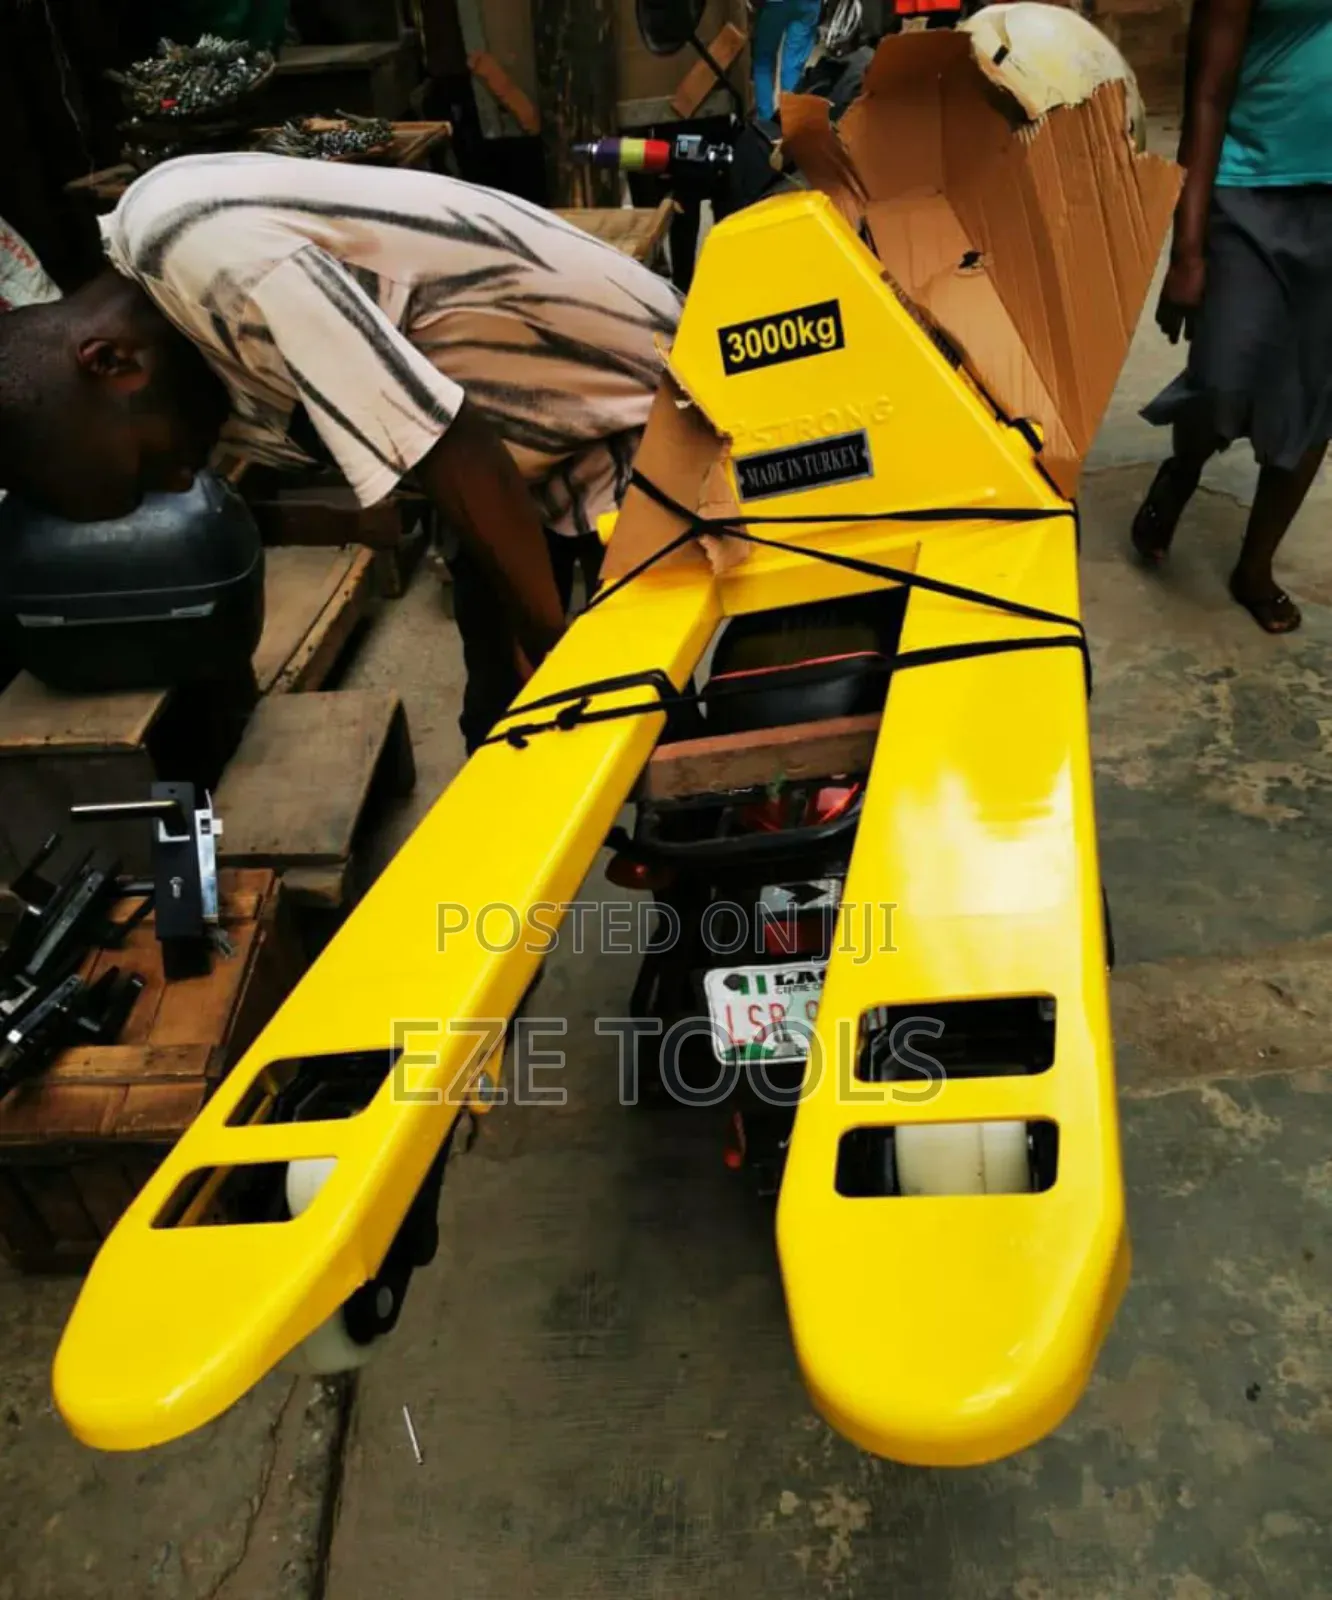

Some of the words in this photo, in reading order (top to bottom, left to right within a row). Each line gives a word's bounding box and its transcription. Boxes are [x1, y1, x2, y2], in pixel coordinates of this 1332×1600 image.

[726, 314, 836, 364] 3000kg
[745, 462, 786, 489] MADE
[786, 457, 804, 480] IN
[803, 443, 861, 477] TURKEY
